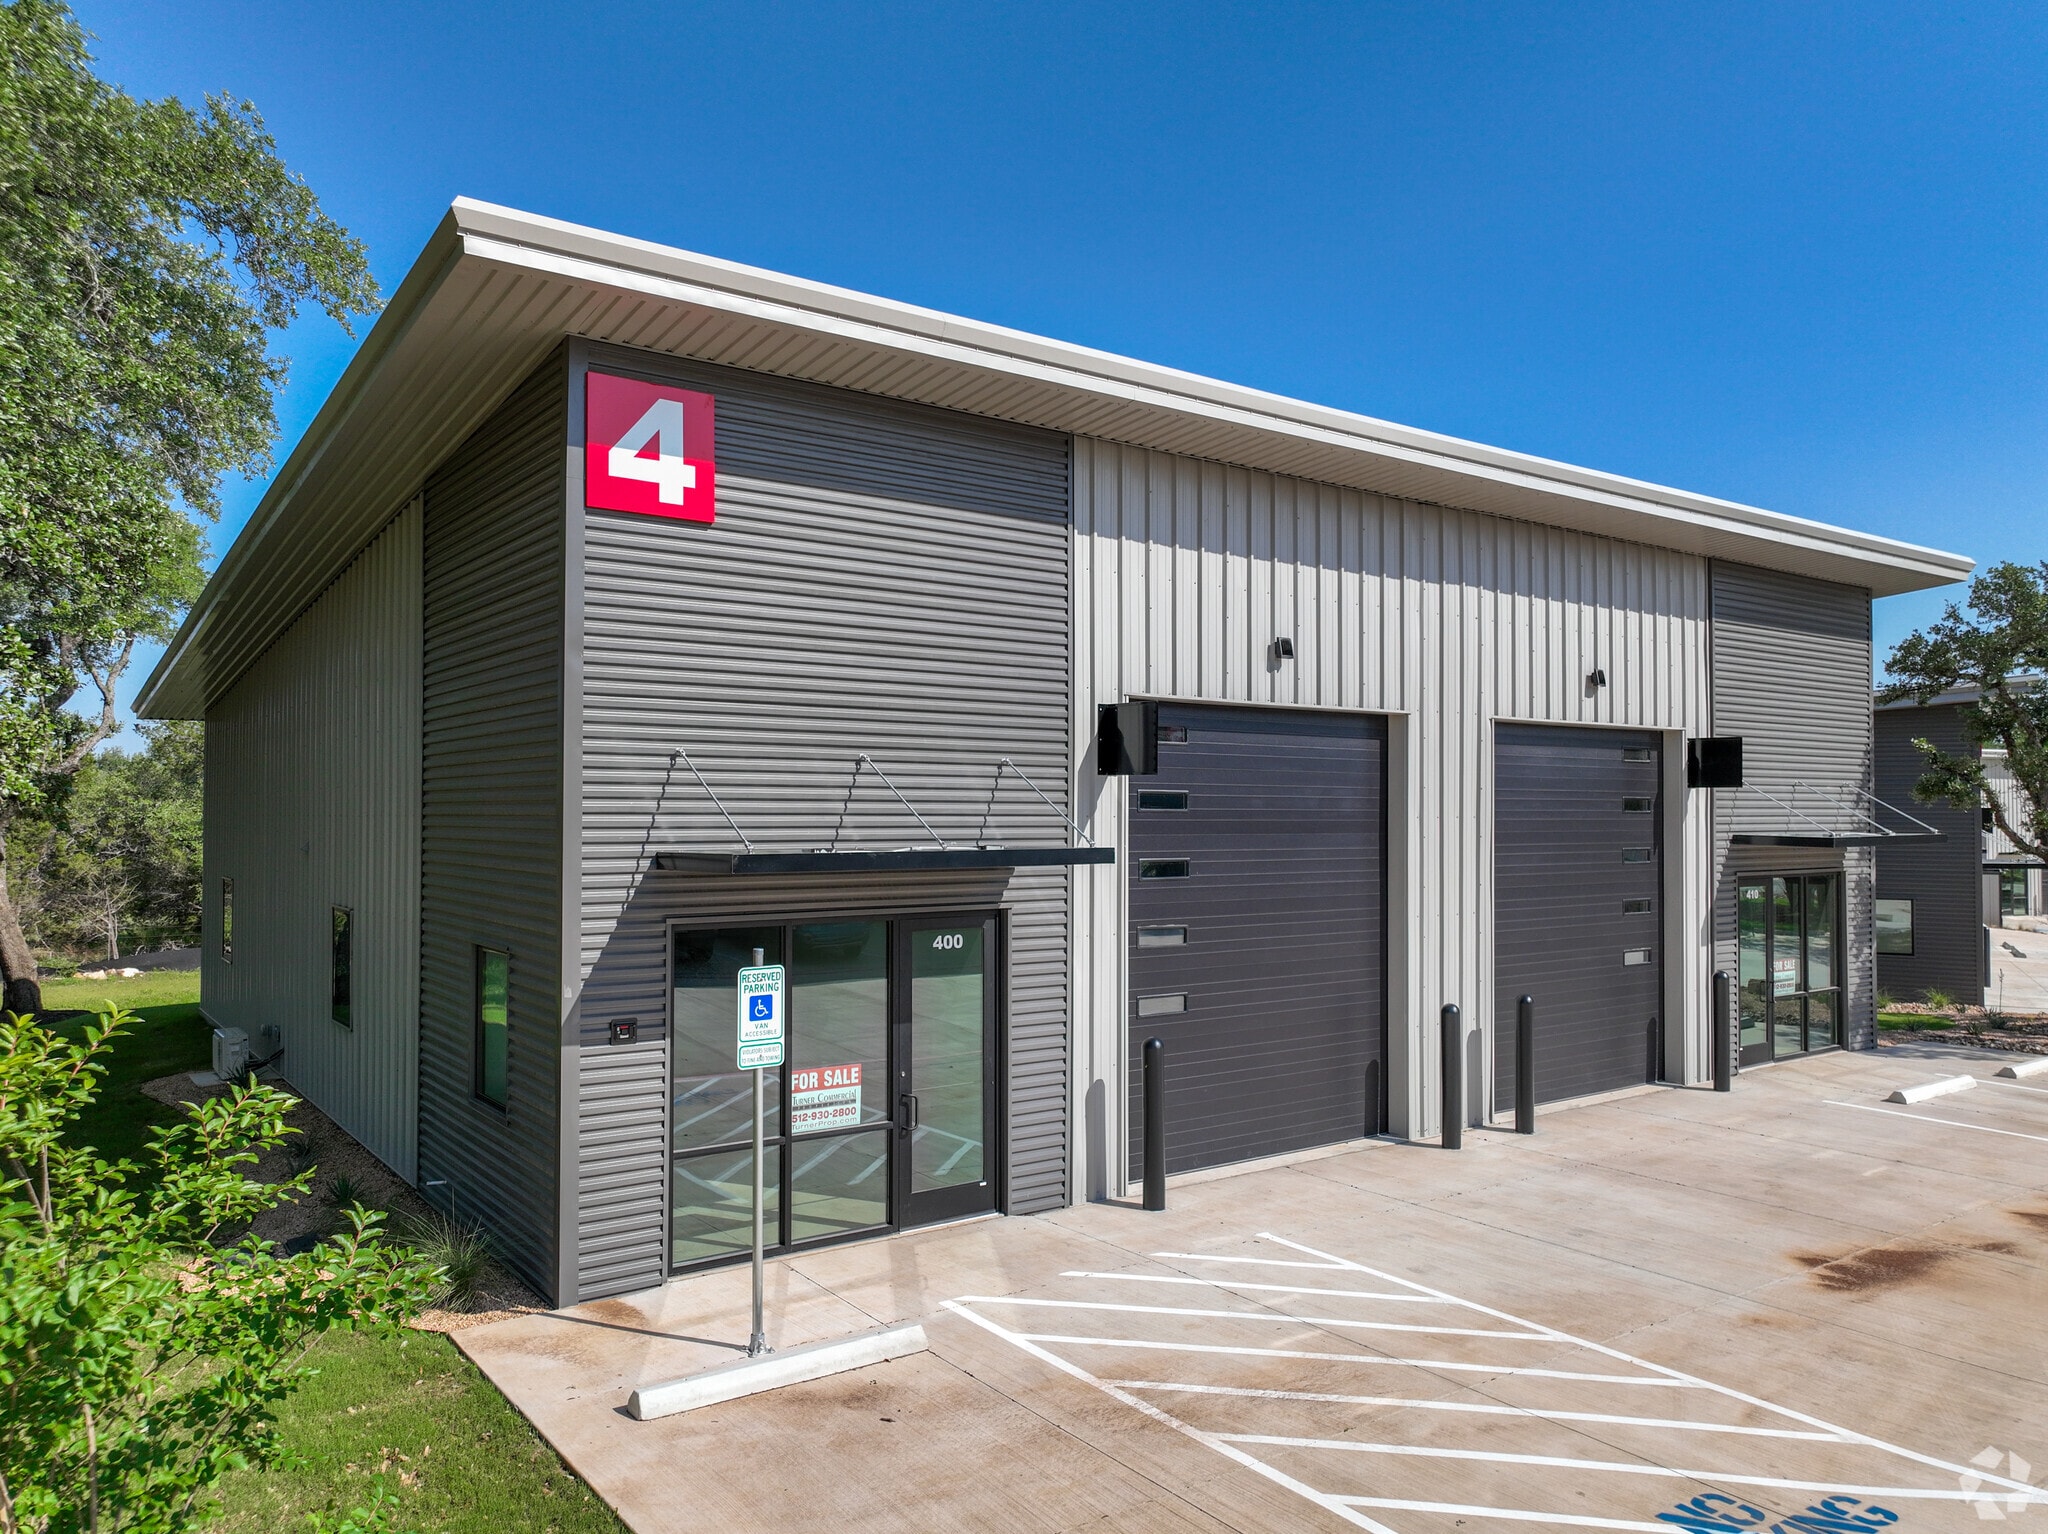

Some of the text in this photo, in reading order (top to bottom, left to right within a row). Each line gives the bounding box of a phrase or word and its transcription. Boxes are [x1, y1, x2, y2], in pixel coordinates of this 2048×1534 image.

[608, 398, 696, 506] 4
[1746, 889, 1759, 899] 410
[932, 934, 963, 950] 400
[1784, 959, 1795, 970] SALE
[742, 971, 781, 984] RESERVED
[743, 982, 779, 994] PARKING
[754, 1022, 769, 1030] VAN
[745, 1029, 778, 1037] ACCESSIBLE
[792, 1067, 859, 1091] FOR SALE
[792, 1117, 858, 1131] TurnerProp.com
[1654, 1493, 1765, 1534] NO
